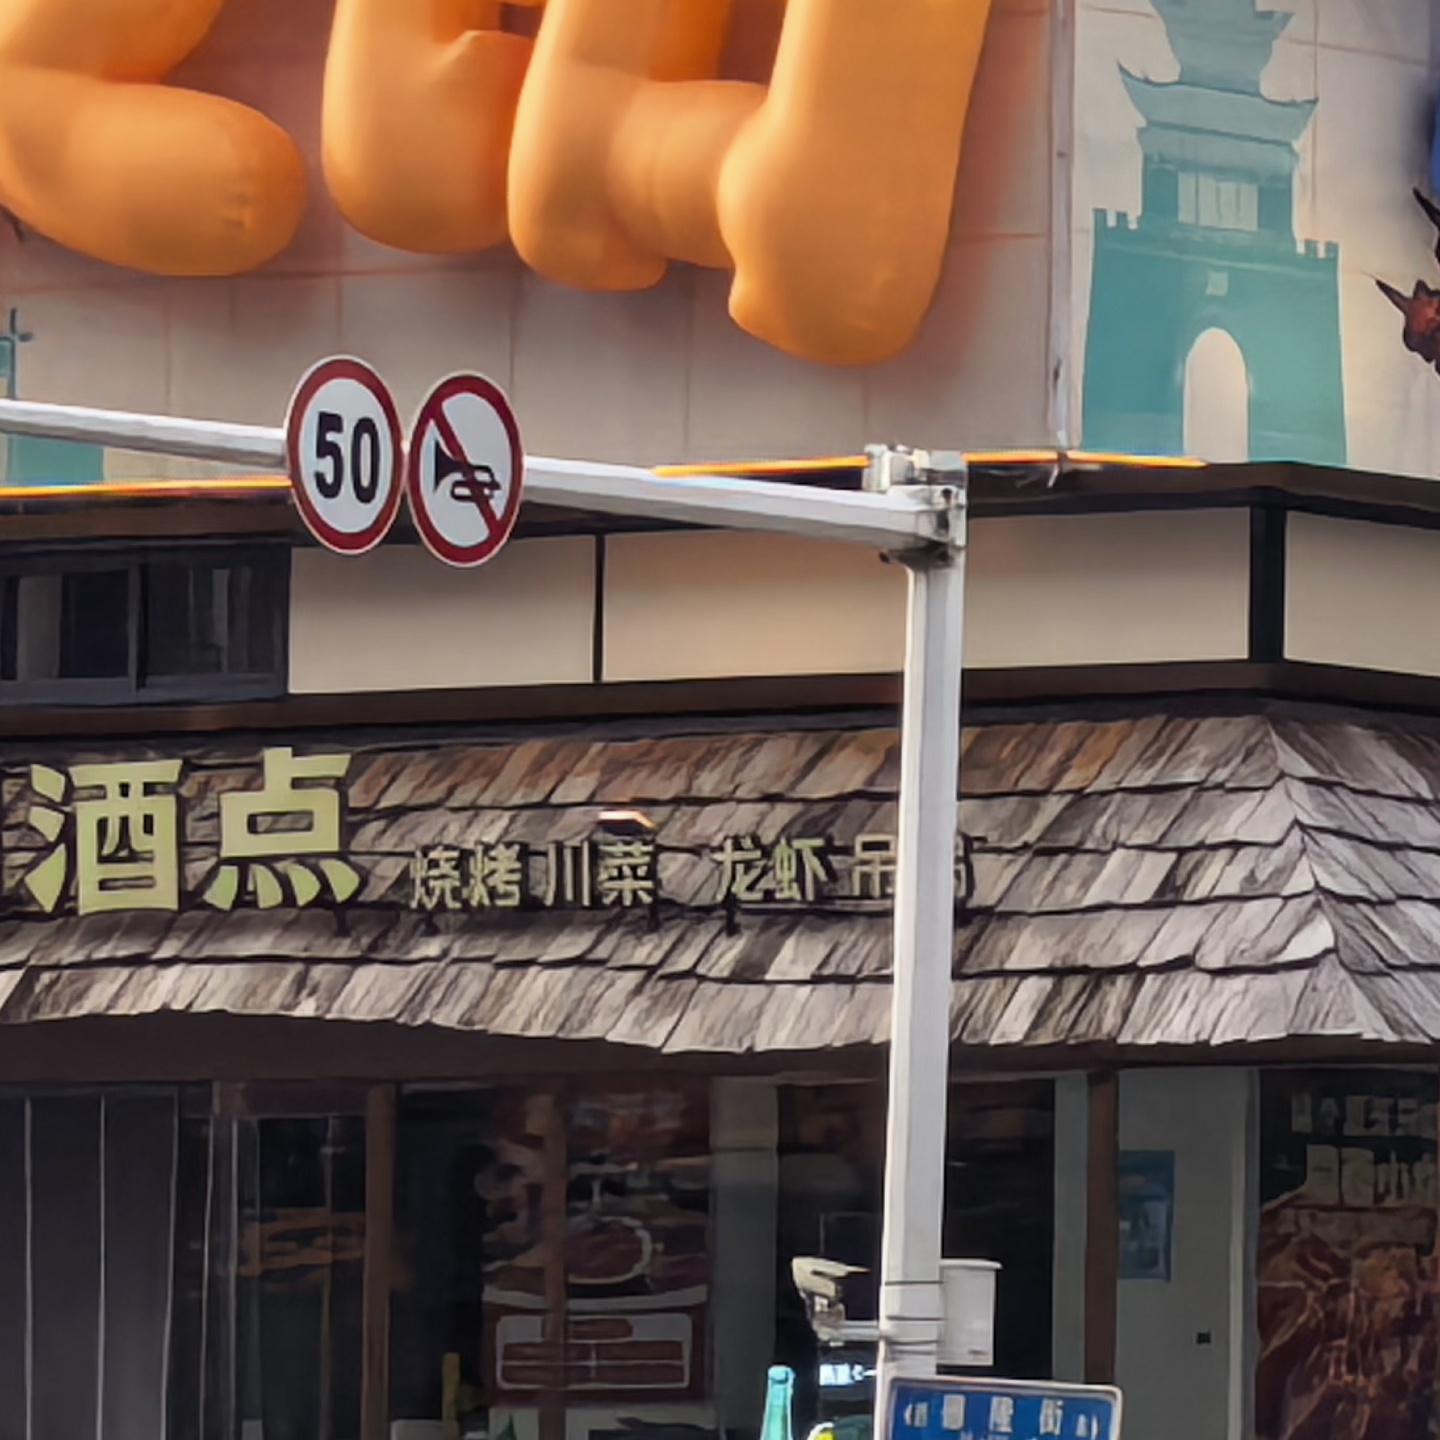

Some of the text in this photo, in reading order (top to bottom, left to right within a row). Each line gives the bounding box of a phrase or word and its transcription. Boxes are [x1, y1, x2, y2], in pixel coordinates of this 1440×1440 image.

[314, 411, 380, 504] 50
[409, 842, 523, 910] 烧烤
[544, 839, 655, 908] 川菜
[715, 834, 828, 901] 龙虾
